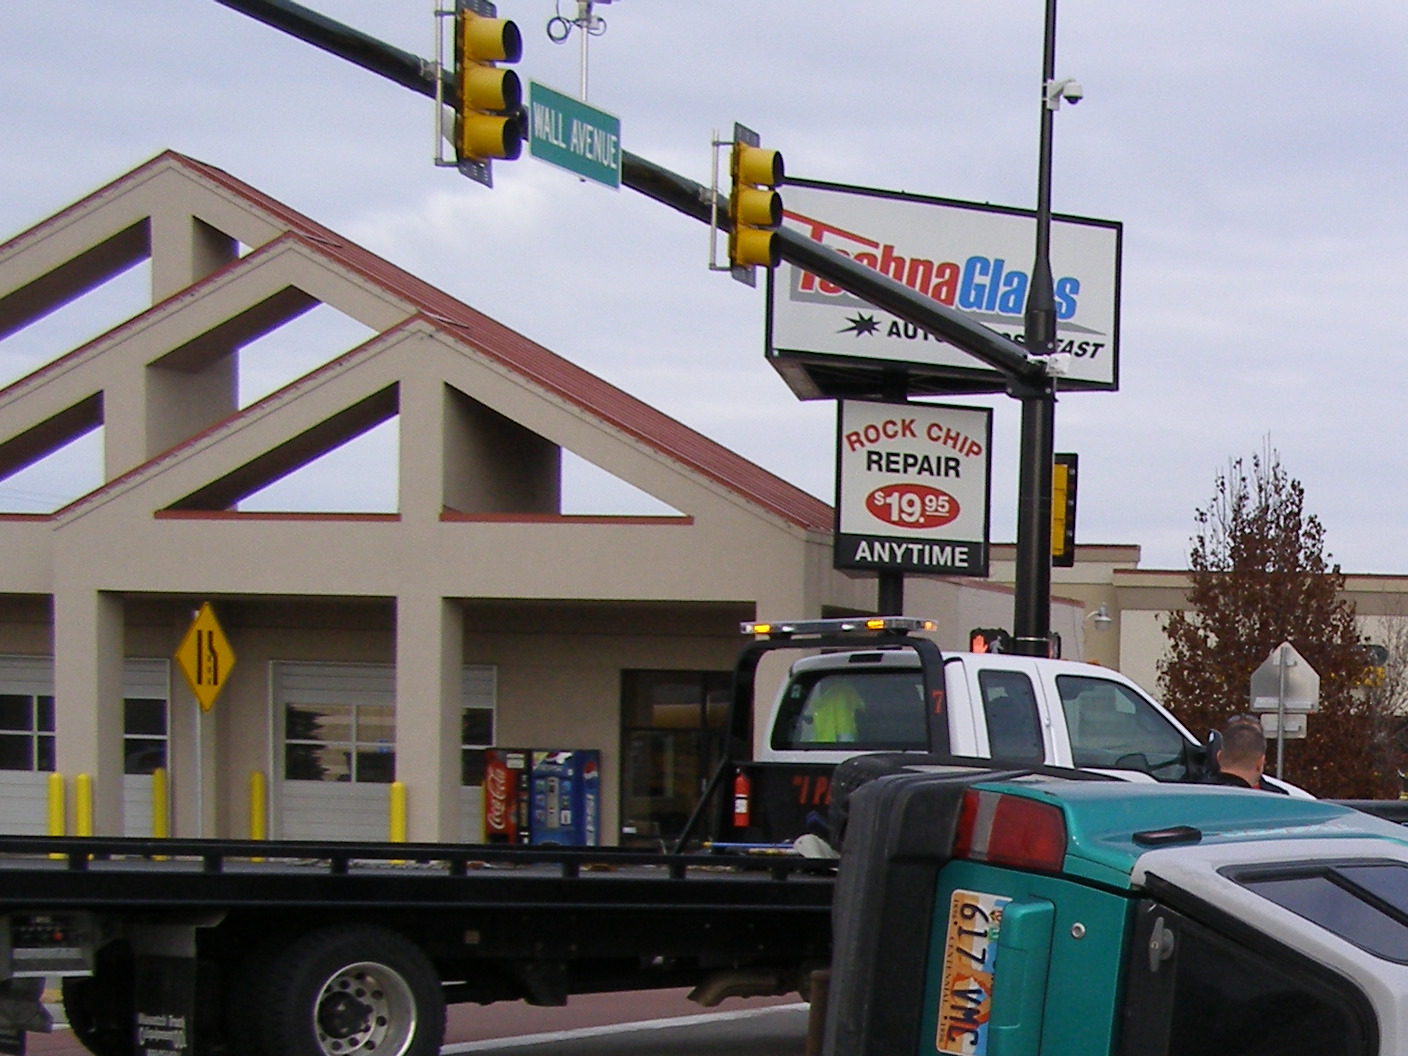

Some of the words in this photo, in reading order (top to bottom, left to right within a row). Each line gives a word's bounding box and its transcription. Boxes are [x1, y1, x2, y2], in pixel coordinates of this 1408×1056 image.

[533, 101, 567, 149] WALL
[570, 119, 618, 170] AVENUE
[782, 209, 1080, 320] ThnaGlas
[845, 418, 918, 452] ROCK
[926, 422, 984, 458] CHIP
[866, 450, 961, 479] REPAIR
[854, 540, 969, 568] ANYTIME
[956, 903, 989, 965] 617
[943, 936, 955, 1004] CENTENNIAL
[947, 988, 983, 1046] VMC
